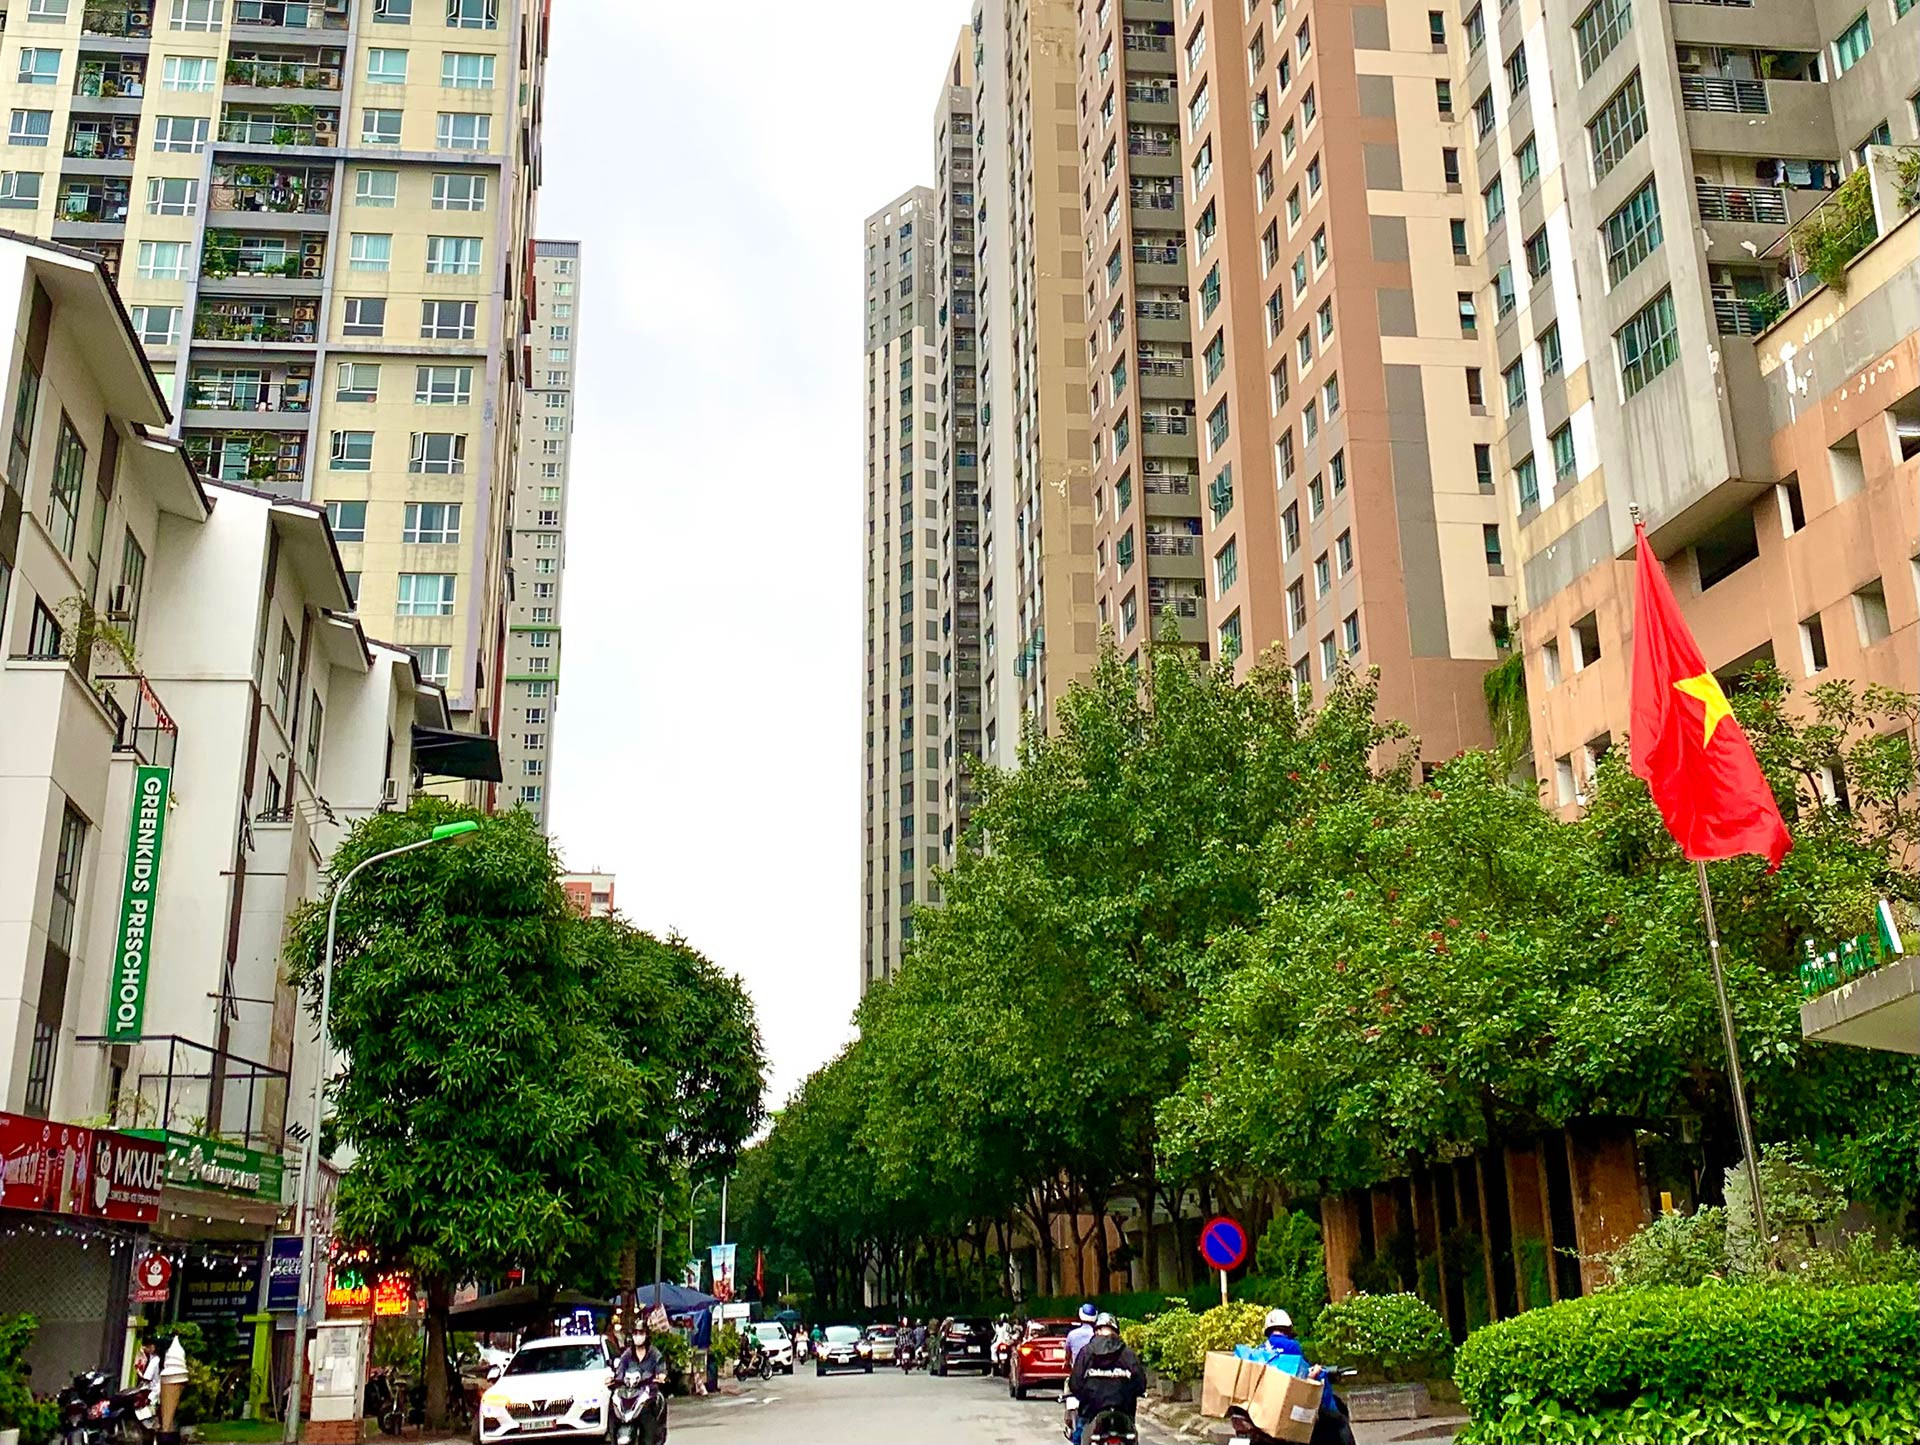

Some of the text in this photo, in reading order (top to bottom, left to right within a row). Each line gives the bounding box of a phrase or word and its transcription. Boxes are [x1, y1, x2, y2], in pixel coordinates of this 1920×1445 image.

[116, 777, 162, 1032] GREENKIDS PRESCHOOL
[113, 1146, 165, 1191] MIXUE
